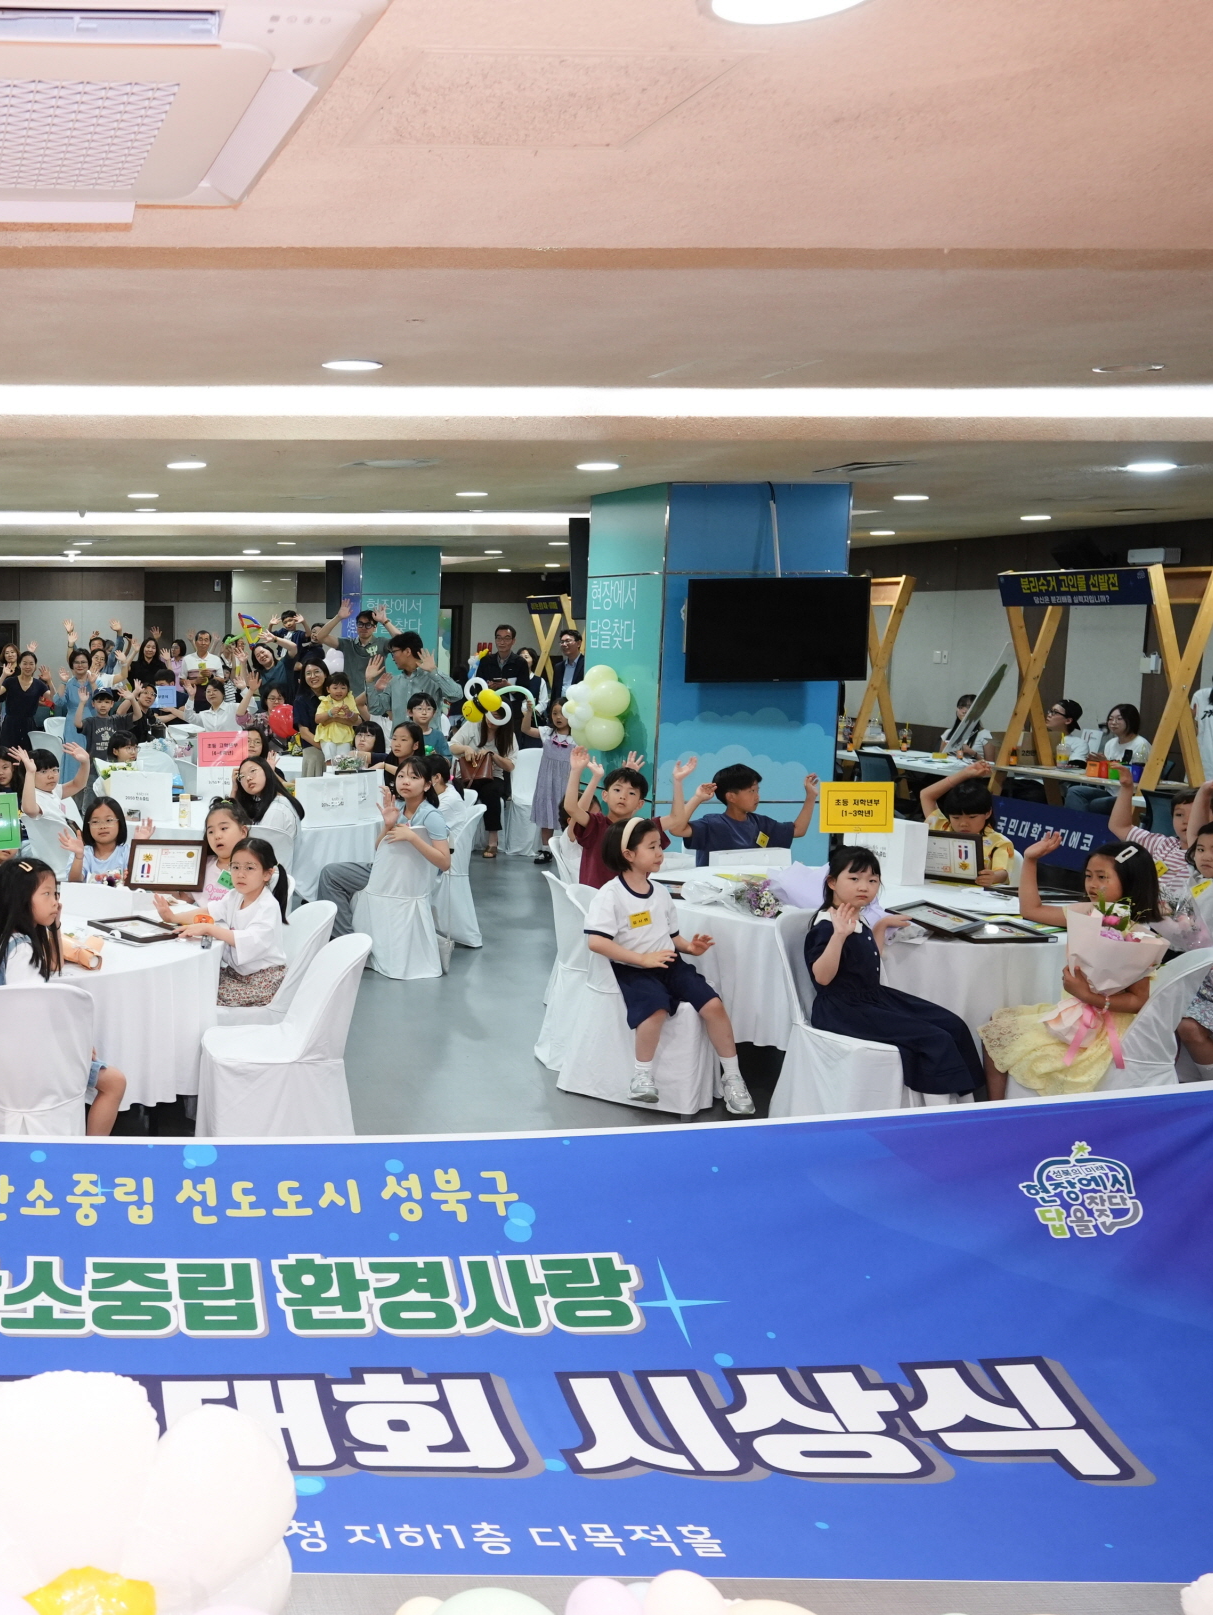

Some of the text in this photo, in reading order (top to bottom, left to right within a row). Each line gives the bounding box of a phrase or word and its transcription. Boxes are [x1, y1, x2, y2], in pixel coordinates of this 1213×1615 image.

[591, 579, 638, 611] 현장에서
[1020, 576, 1058, 593] 분리수거
[1059, 574, 1087, 592] 고인물
[1088, 573, 1120, 591] 선발전
[834, 798, 881, 807] 초등 저학년부
[1049, 1162, 1109, 1180] 성북의 미래
[175, 1175, 363, 1225] 선도도시
[381, 1167, 519, 1223] 성북구
[270, 1250, 646, 1336] 환경사랑
[558, 1356, 1152, 1484] 시상식
[286, 1519, 727, 1558] 청 지하1층 다목적홀
